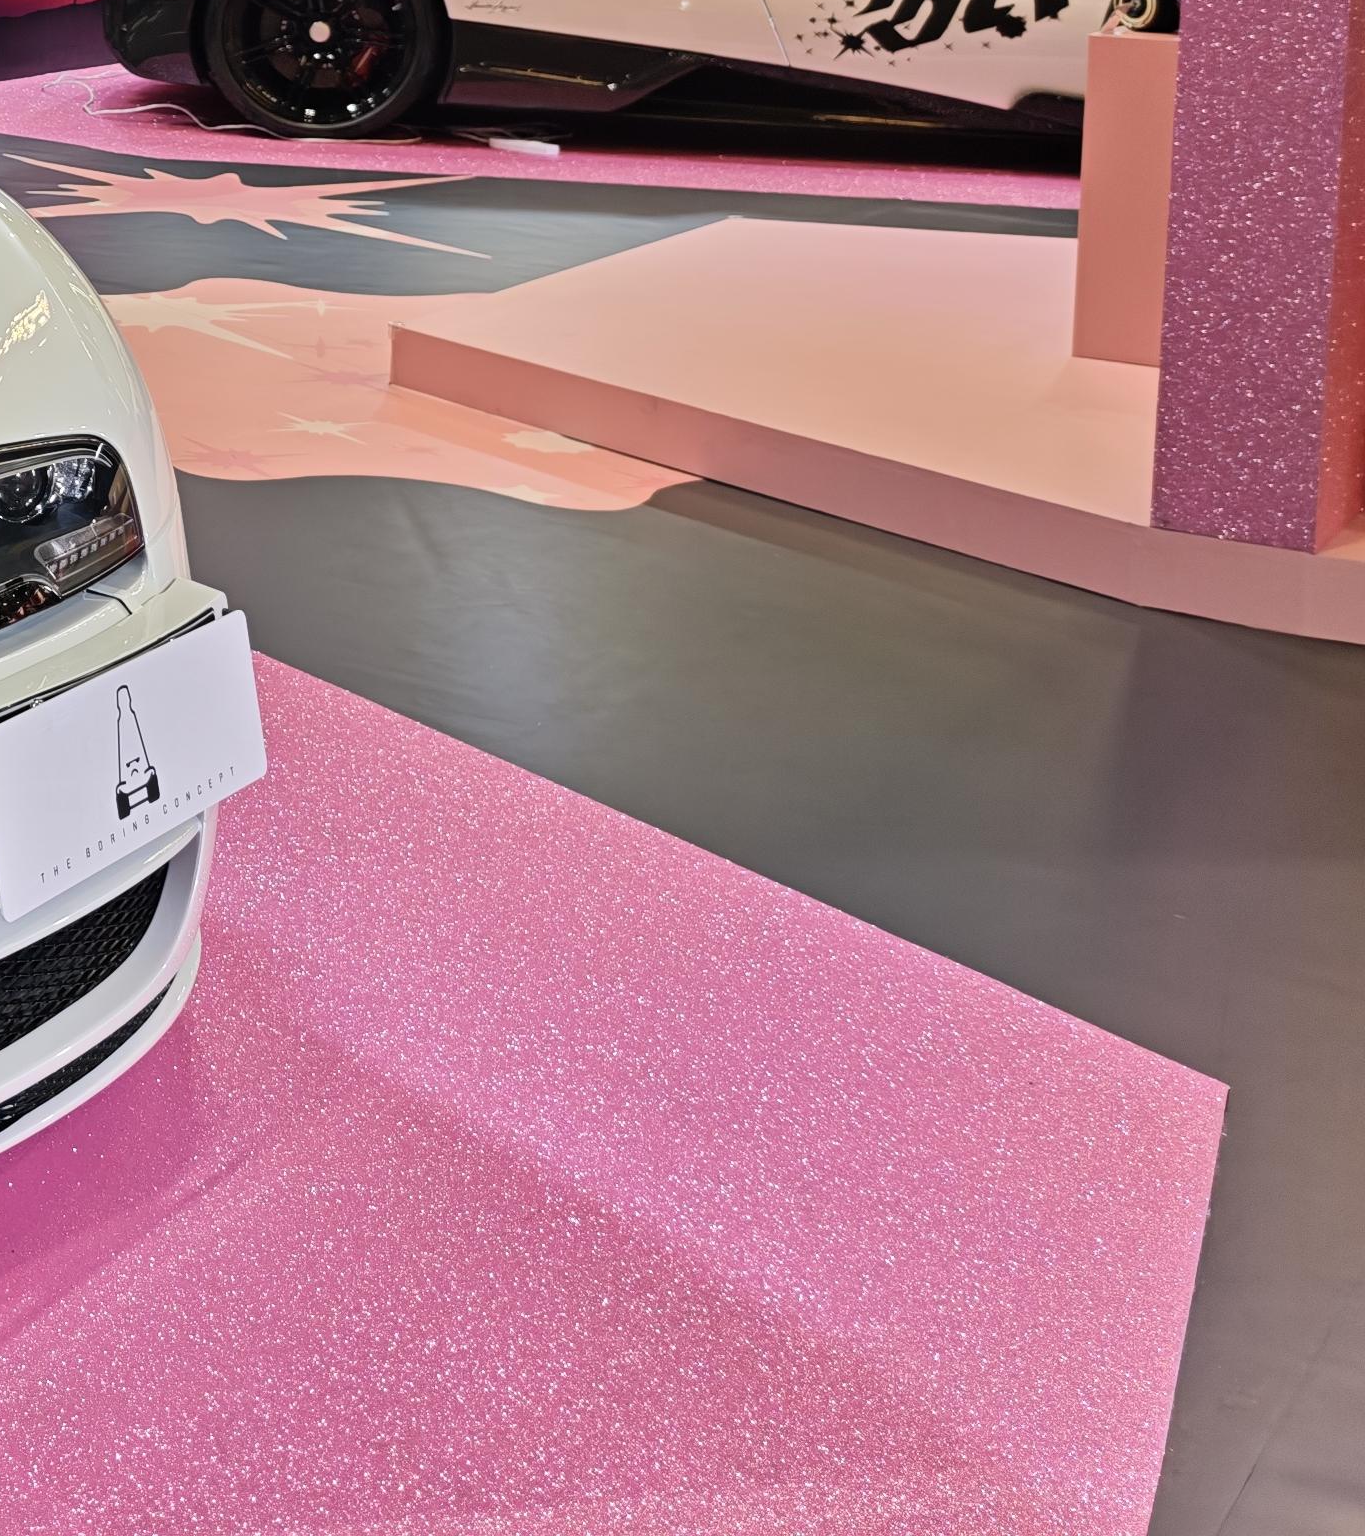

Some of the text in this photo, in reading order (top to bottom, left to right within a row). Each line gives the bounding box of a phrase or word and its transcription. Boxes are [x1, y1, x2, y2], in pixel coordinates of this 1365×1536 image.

[39, 765, 236, 885] THE BORING CONCEPT
